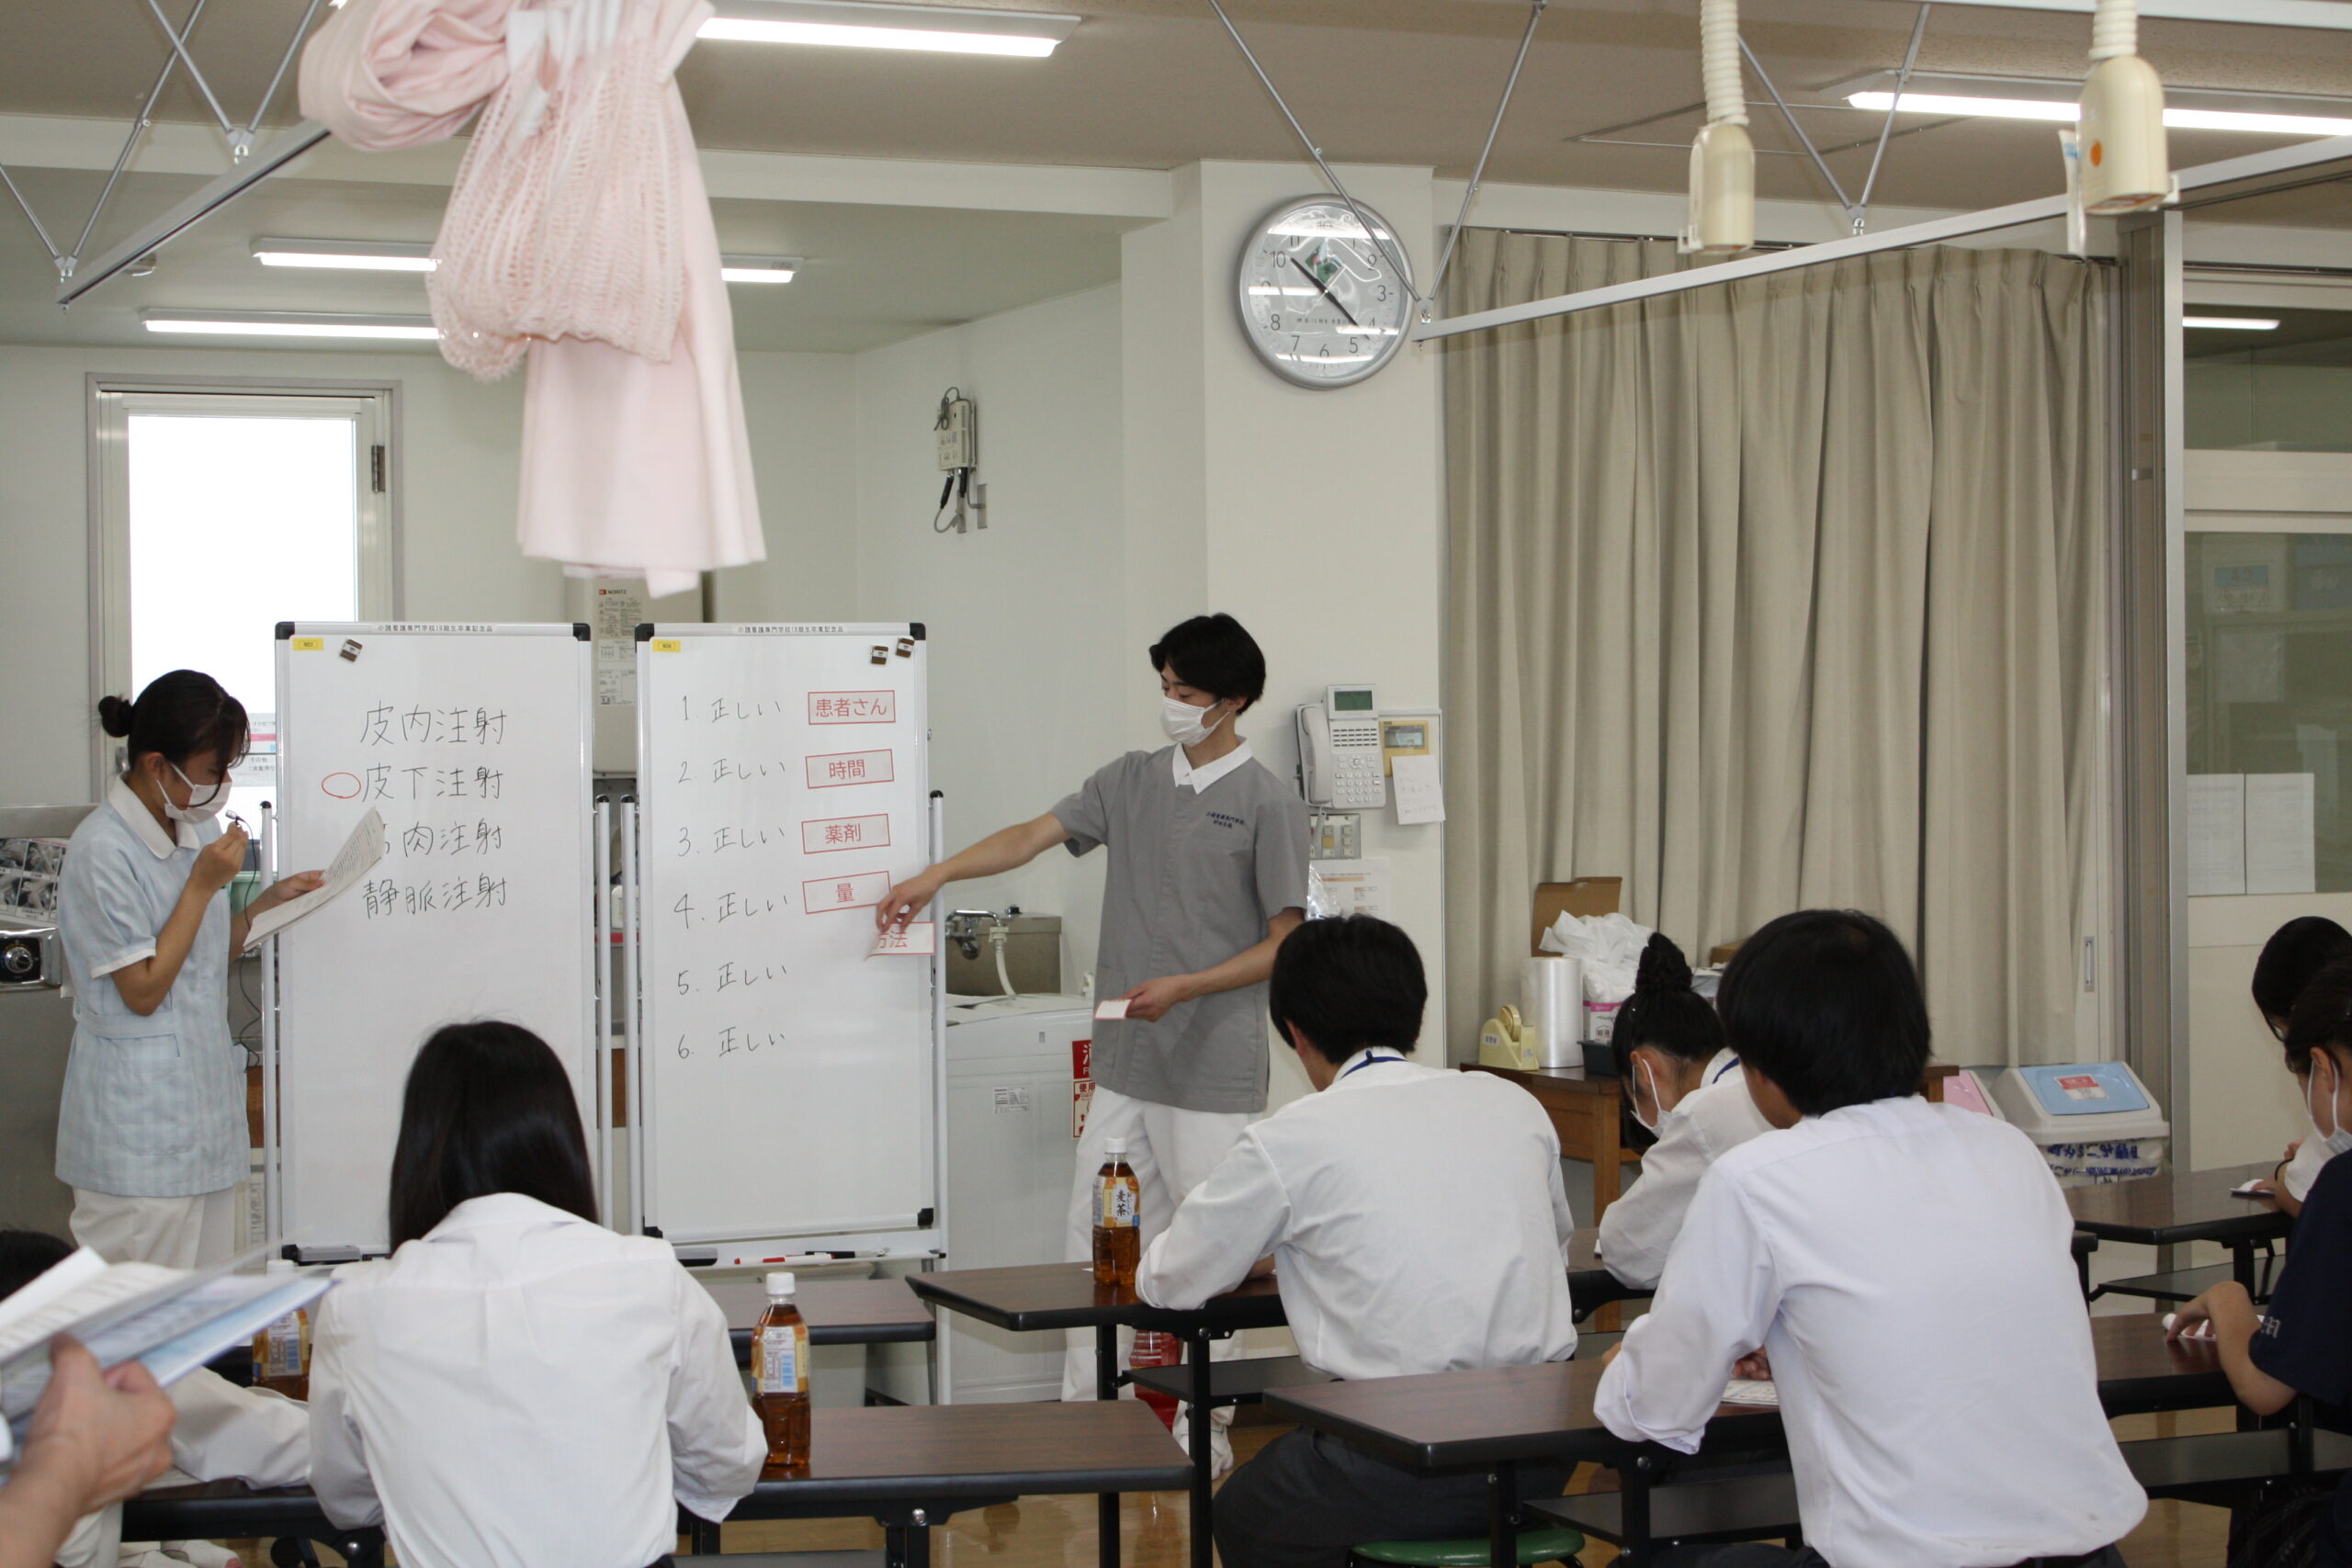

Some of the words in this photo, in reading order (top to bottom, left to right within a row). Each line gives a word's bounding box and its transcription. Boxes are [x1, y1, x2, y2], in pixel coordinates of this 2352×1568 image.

[1271, 251, 1286, 268] 10
[1368, 254, 1377, 271] 2
[1376, 285, 1386, 302] 3
[1271, 313, 1281, 331] 8
[1291, 334, 1300, 351] 7
[1319, 344, 1329, 357] 6
[1349, 336, 1359, 354] 5
[711, 698, 781, 724] 正しい
[816, 698, 888, 718] 患者さん
[360, 700, 507, 746] 皮内注射
[713, 758, 785, 784] 正しい
[829, 759, 866, 780] 時間
[362, 762, 503, 803] 皮下注射
[383, 818, 503, 858] 肉注射
[714, 827, 785, 853] 正しい
[824, 822, 862, 844] 薬剤
[363, 873, 507, 919] 静脈注射
[835, 883, 855, 905] 量
[718, 891, 787, 923] 正しい
[717, 962, 786, 992] 正しい
[718, 1026, 786, 1057] 正しい
[1116, 1189, 1126, 1217] 麦茶
